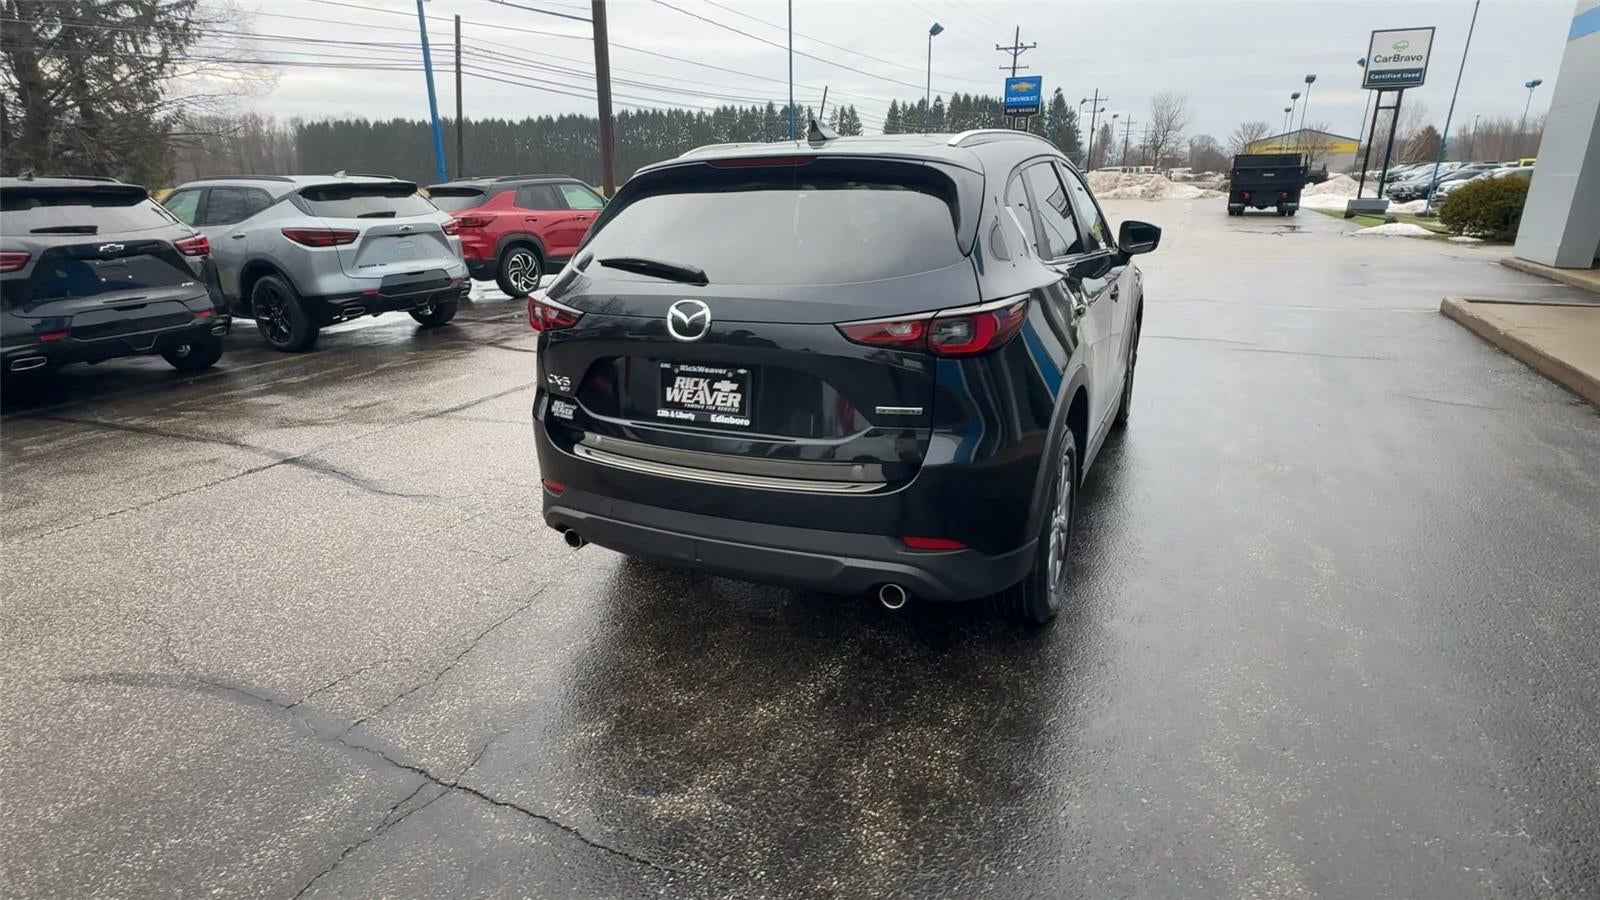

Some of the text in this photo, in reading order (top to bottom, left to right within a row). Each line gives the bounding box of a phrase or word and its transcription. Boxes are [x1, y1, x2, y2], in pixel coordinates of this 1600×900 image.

[1374, 54, 1423, 63] CarBravo
[674, 376, 710, 391] RICK
[666, 387, 741, 408] WEAVER
[657, 409, 670, 417] 12th
[710, 414, 750, 426] Edinboro
